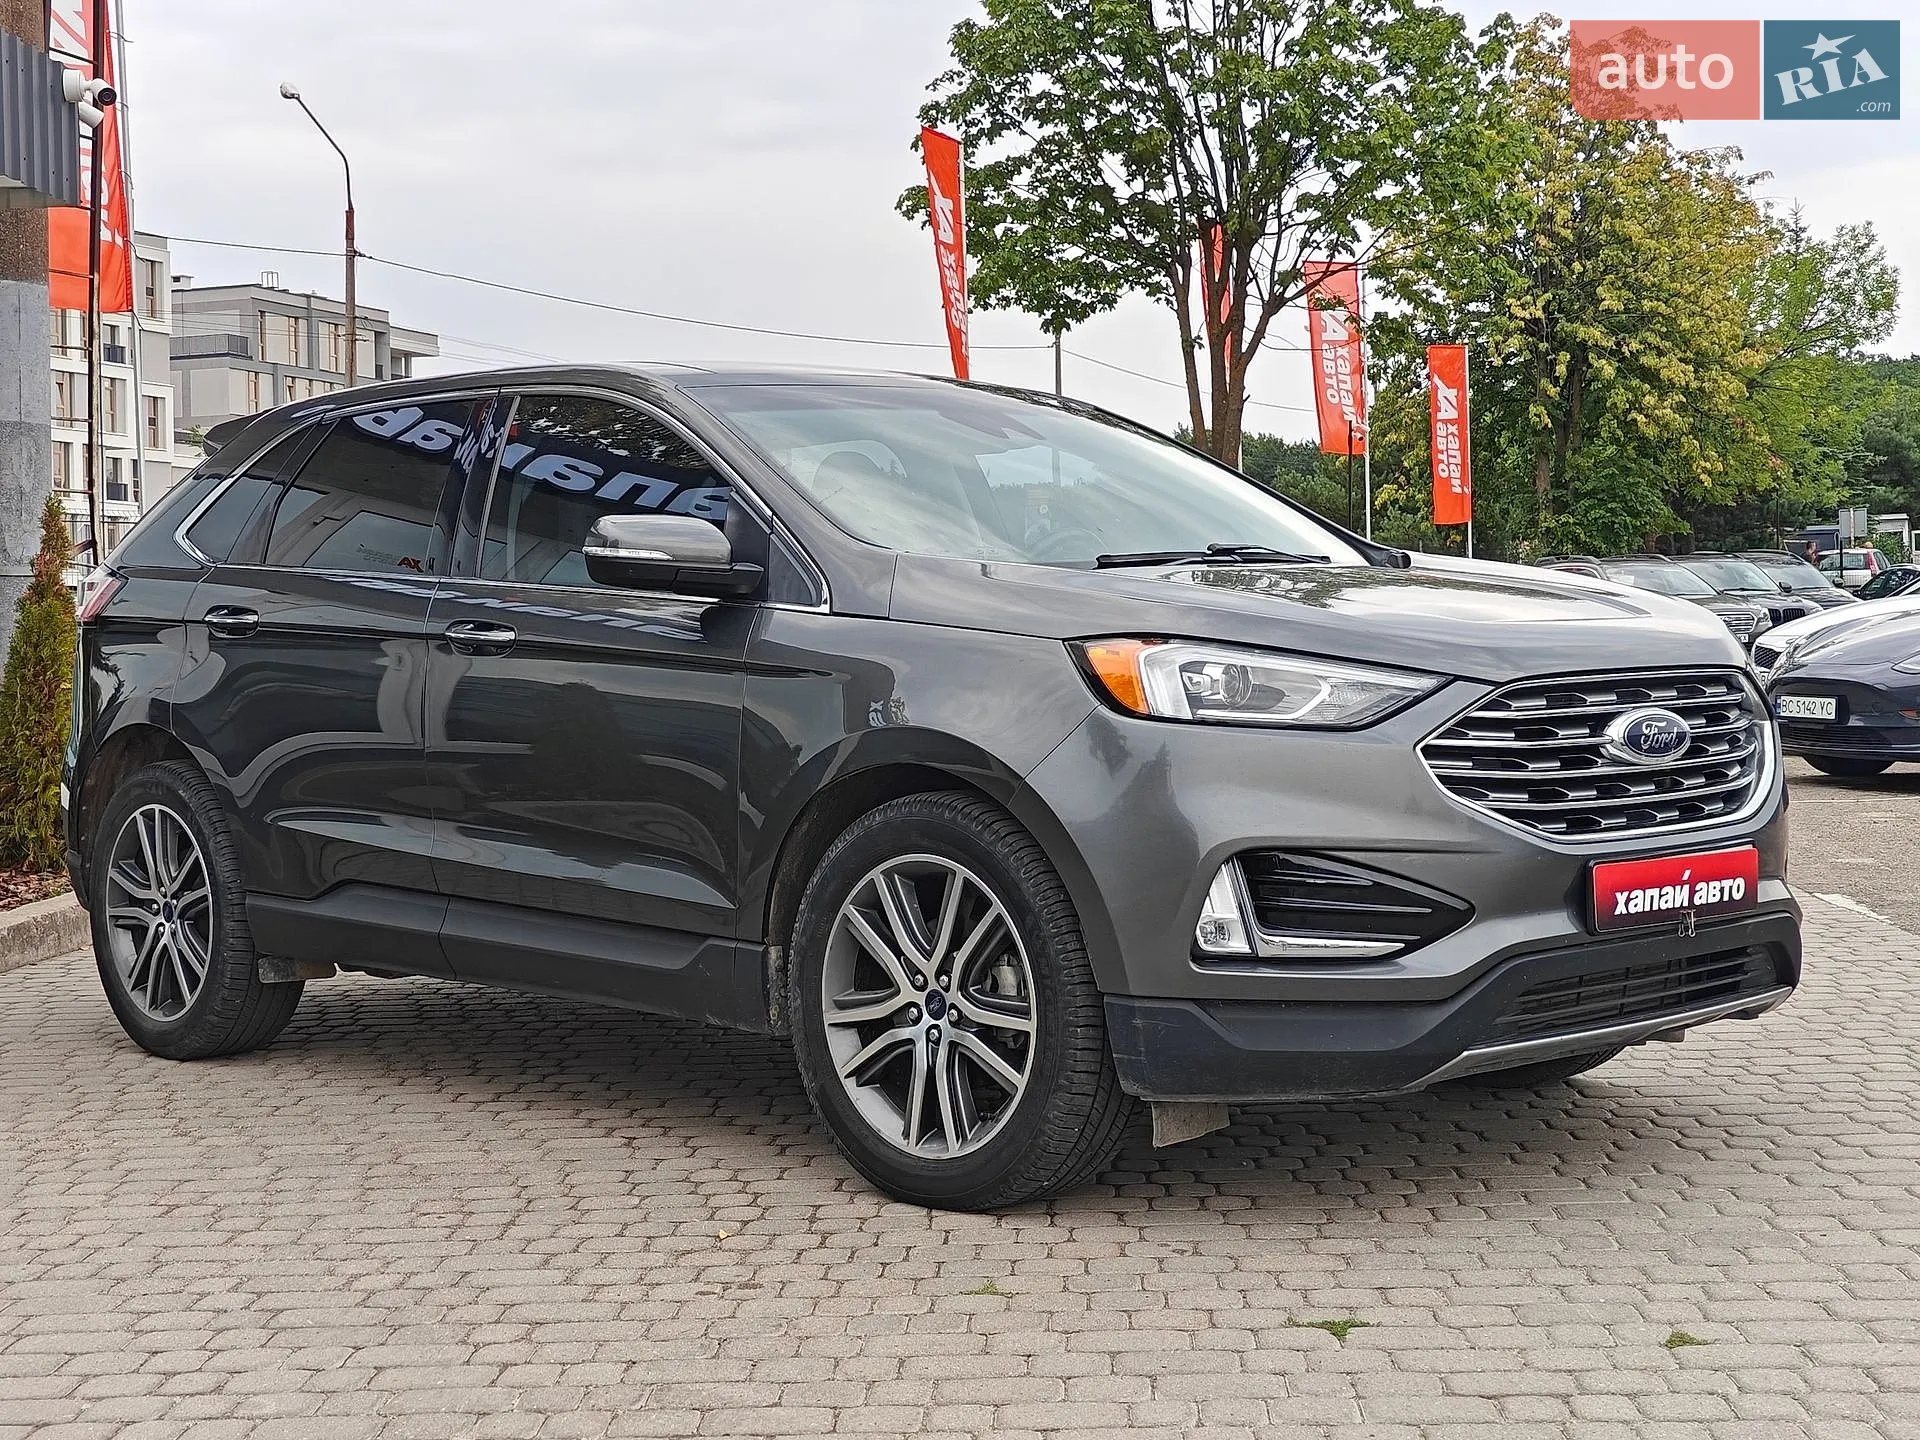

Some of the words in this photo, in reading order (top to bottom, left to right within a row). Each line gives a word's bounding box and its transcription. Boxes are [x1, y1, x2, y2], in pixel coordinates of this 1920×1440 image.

[1321, 342, 1340, 405] авто
[1437, 422, 1449, 479] авто
[1446, 422, 1470, 495] хапай
[1782, 699, 1794, 713] BC
[1796, 700, 1817, 715] 5142
[1820, 701, 1833, 715] YC
[1641, 721, 1678, 750] Ford
[1614, 869, 1691, 915] хапай
[1694, 877, 1745, 905] авто
